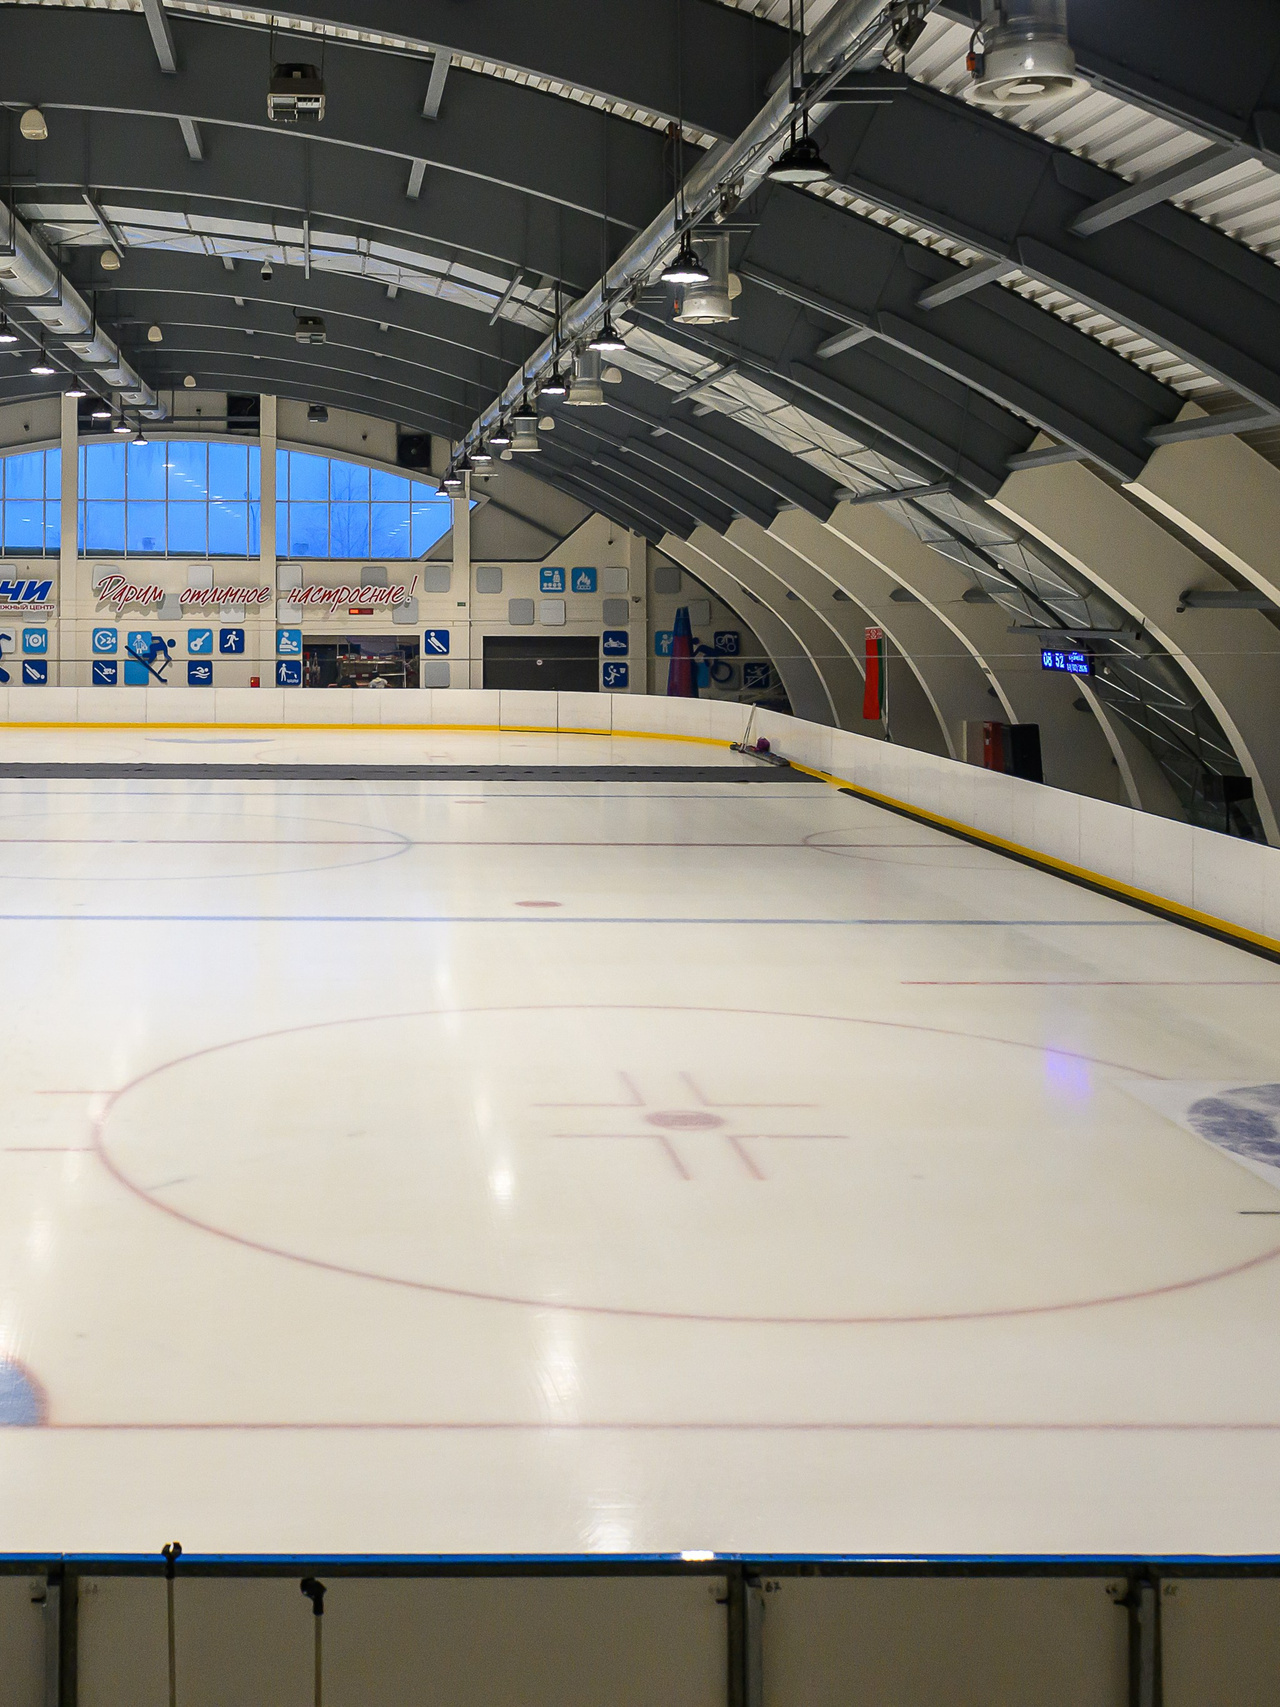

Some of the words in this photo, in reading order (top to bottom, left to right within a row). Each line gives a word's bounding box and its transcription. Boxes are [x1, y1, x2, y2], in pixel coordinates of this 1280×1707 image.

[97, 575, 164, 611] Дарим
[180, 584, 269, 605] отличное
[287, 575, 418, 613] настроение!
